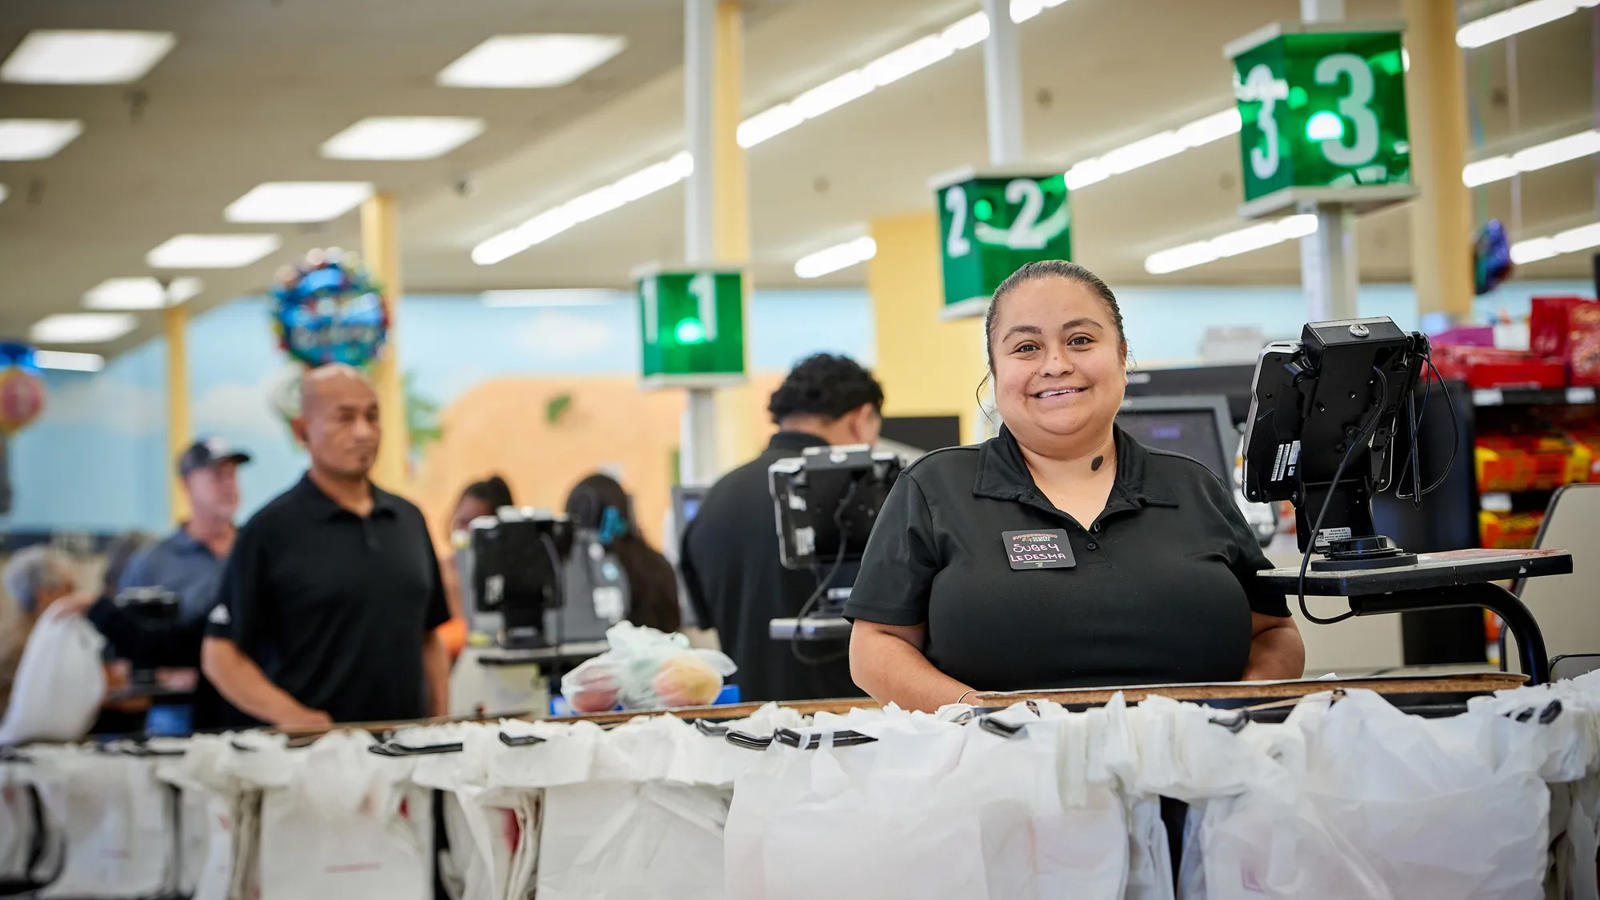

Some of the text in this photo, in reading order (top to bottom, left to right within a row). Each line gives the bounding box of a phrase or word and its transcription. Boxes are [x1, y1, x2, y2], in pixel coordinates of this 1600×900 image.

[1250, 63, 1279, 179] 3
[1315, 53, 1380, 167] 3
[946, 185, 970, 258] 2
[1005, 179, 1047, 249] 2
[641, 276, 659, 344] 1
[689, 273, 718, 342] 1
[1010, 553, 1066, 562] LEDESMA
